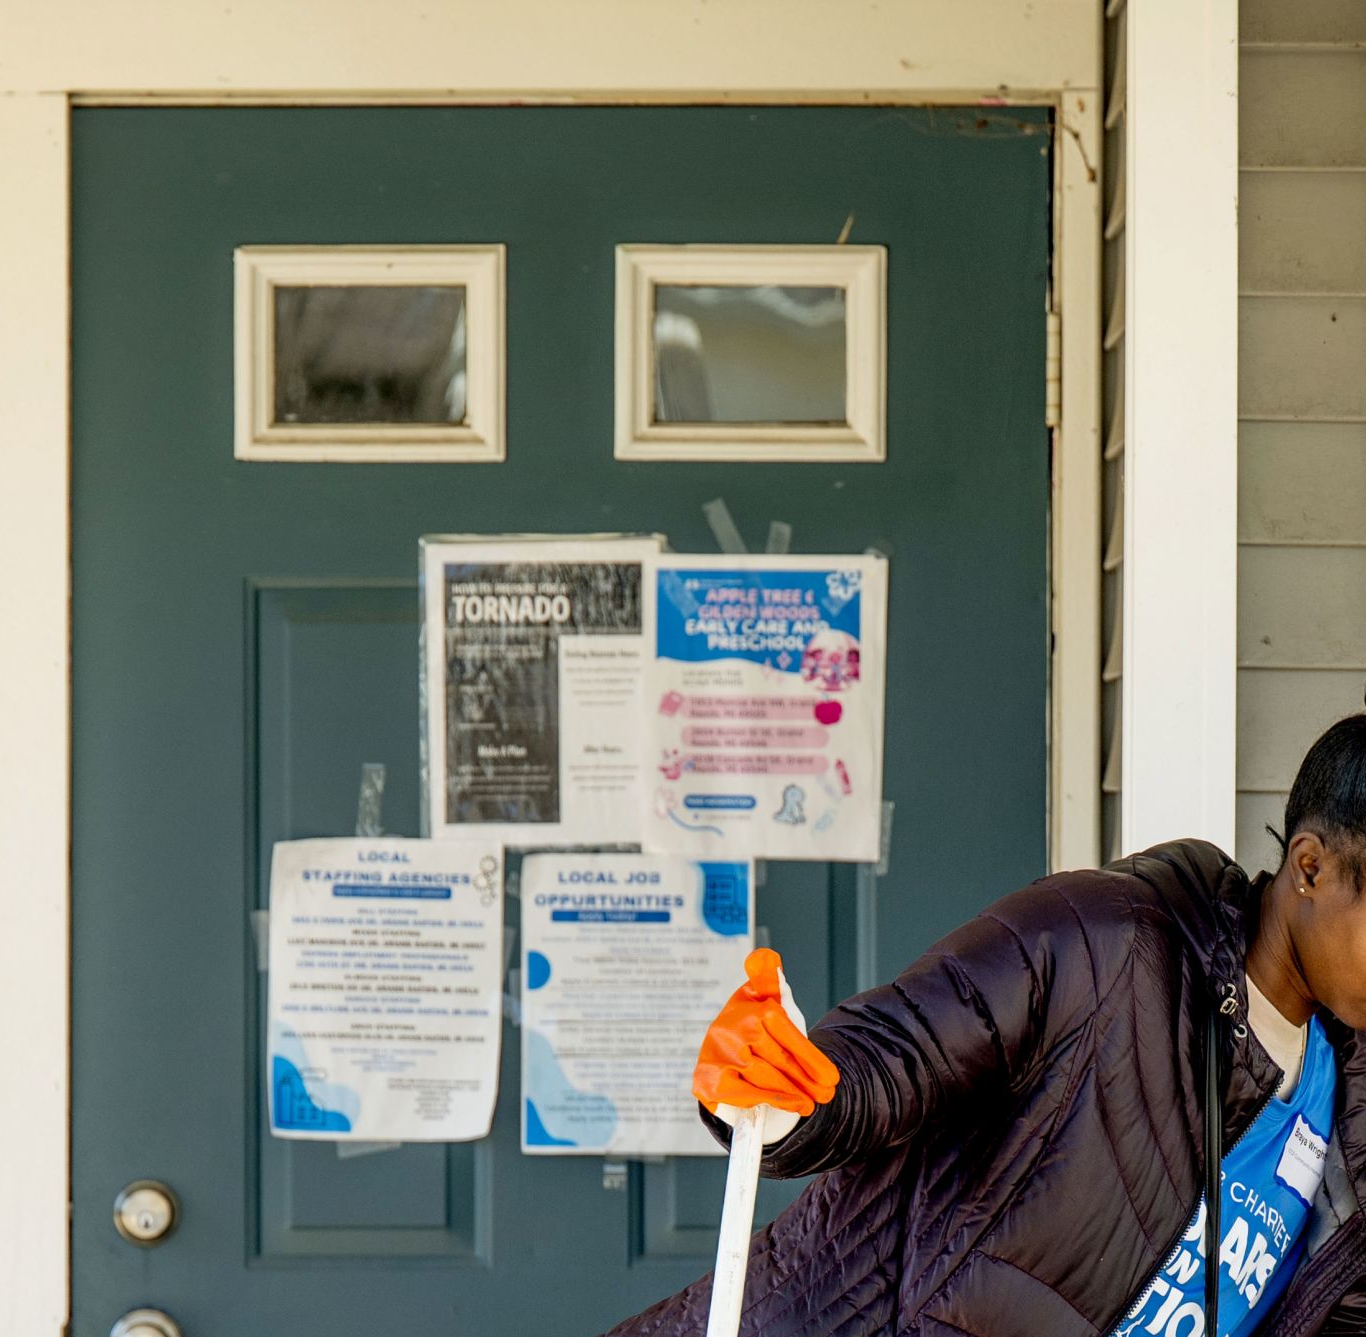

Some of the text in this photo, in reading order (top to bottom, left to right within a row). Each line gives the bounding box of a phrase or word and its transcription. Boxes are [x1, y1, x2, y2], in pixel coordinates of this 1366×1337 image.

[705, 588, 757, 603] APPLE
[762, 588, 801, 604] TREE
[452, 595, 570, 624] TORNADO
[759, 605, 820, 620] WOODS
[685, 619, 830, 636] EARLY CARE AND
[707, 634, 805, 651] PRESCHOOL
[357, 852, 410, 864] LOCAL
[302, 870, 471, 885] STAFFING AGENCIES
[558, 871, 661, 884] LOCAL JOB
